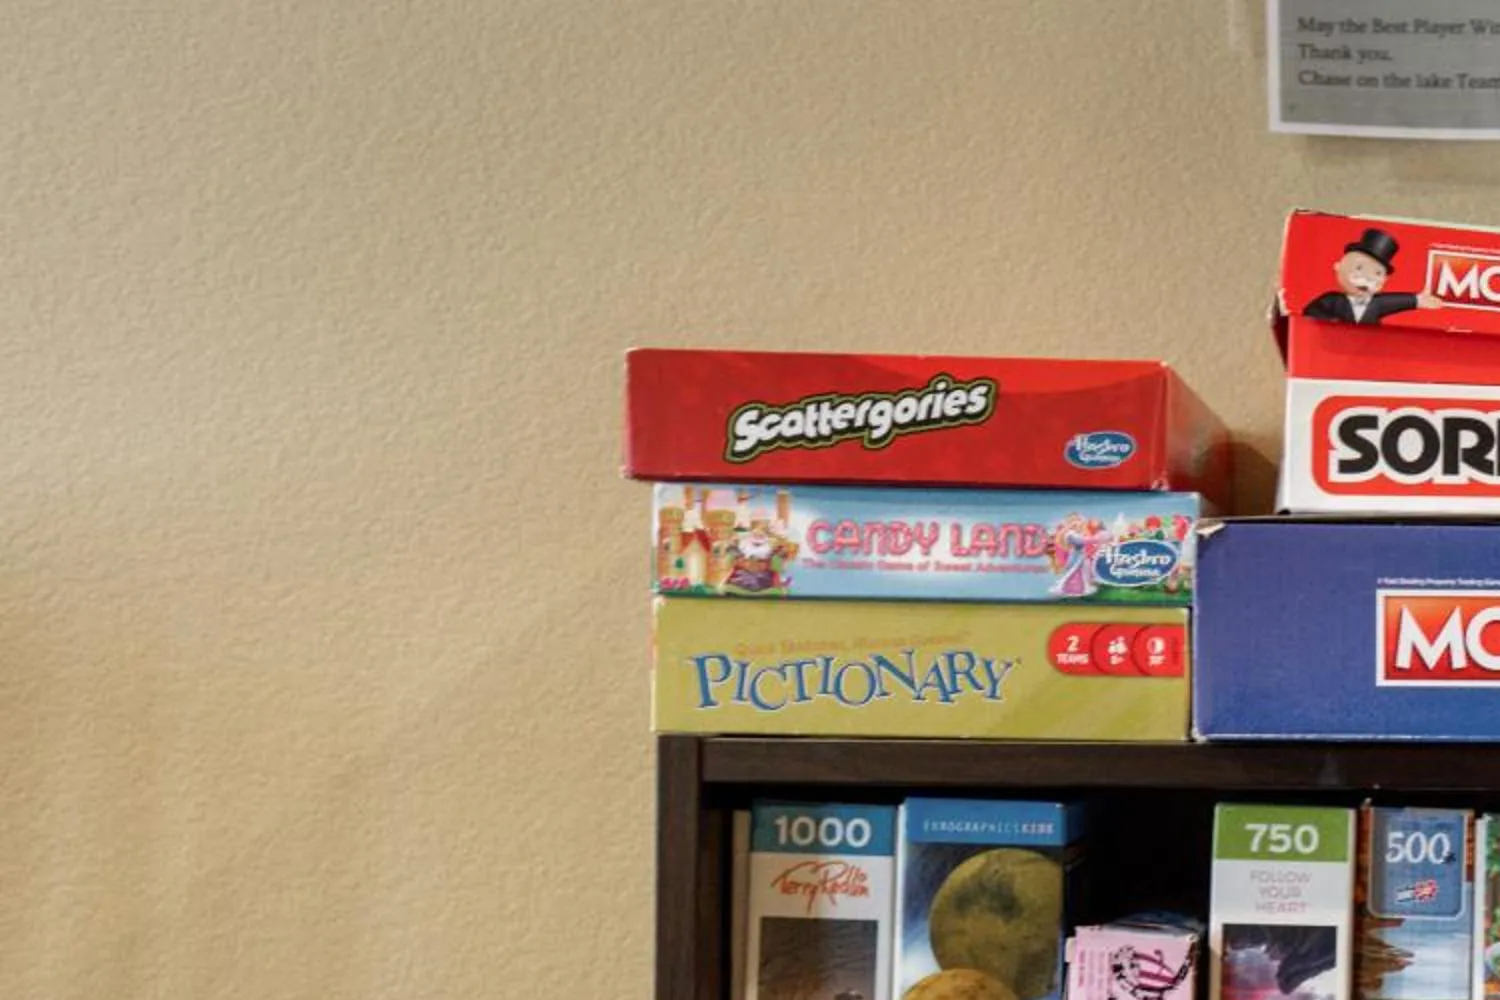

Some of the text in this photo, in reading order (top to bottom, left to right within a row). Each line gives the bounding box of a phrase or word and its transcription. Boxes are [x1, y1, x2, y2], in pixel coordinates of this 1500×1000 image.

[1297, 17, 1336, 35] May
[1339, 19, 1368, 33] the
[1372, 19, 1408, 33] Best
[1413, 19, 1466, 37] Player
[1299, 44, 1352, 60] Thank
[1299, 72, 1352, 88] Chase
[1356, 77, 1378, 88] on
[1384, 73, 1411, 88] the
[733, 381, 988, 452] Scattergories
[1074, 434, 1130, 454] Hasbro
[805, 519, 1051, 558] CANDY LAND
[1103, 543, 1171, 568] Hasbro
[1066, 635, 1080, 653] 2
[690, 650, 1013, 711] PICTIONARY
[775, 816, 871, 848] 1000
[1245, 823, 1319, 854] 750
[1385, 831, 1450, 864] 500
[1250, 870, 1311, 884] FOLLOW
[1259, 884, 1301, 899] YOUR
[1255, 900, 1309, 914] HEART
